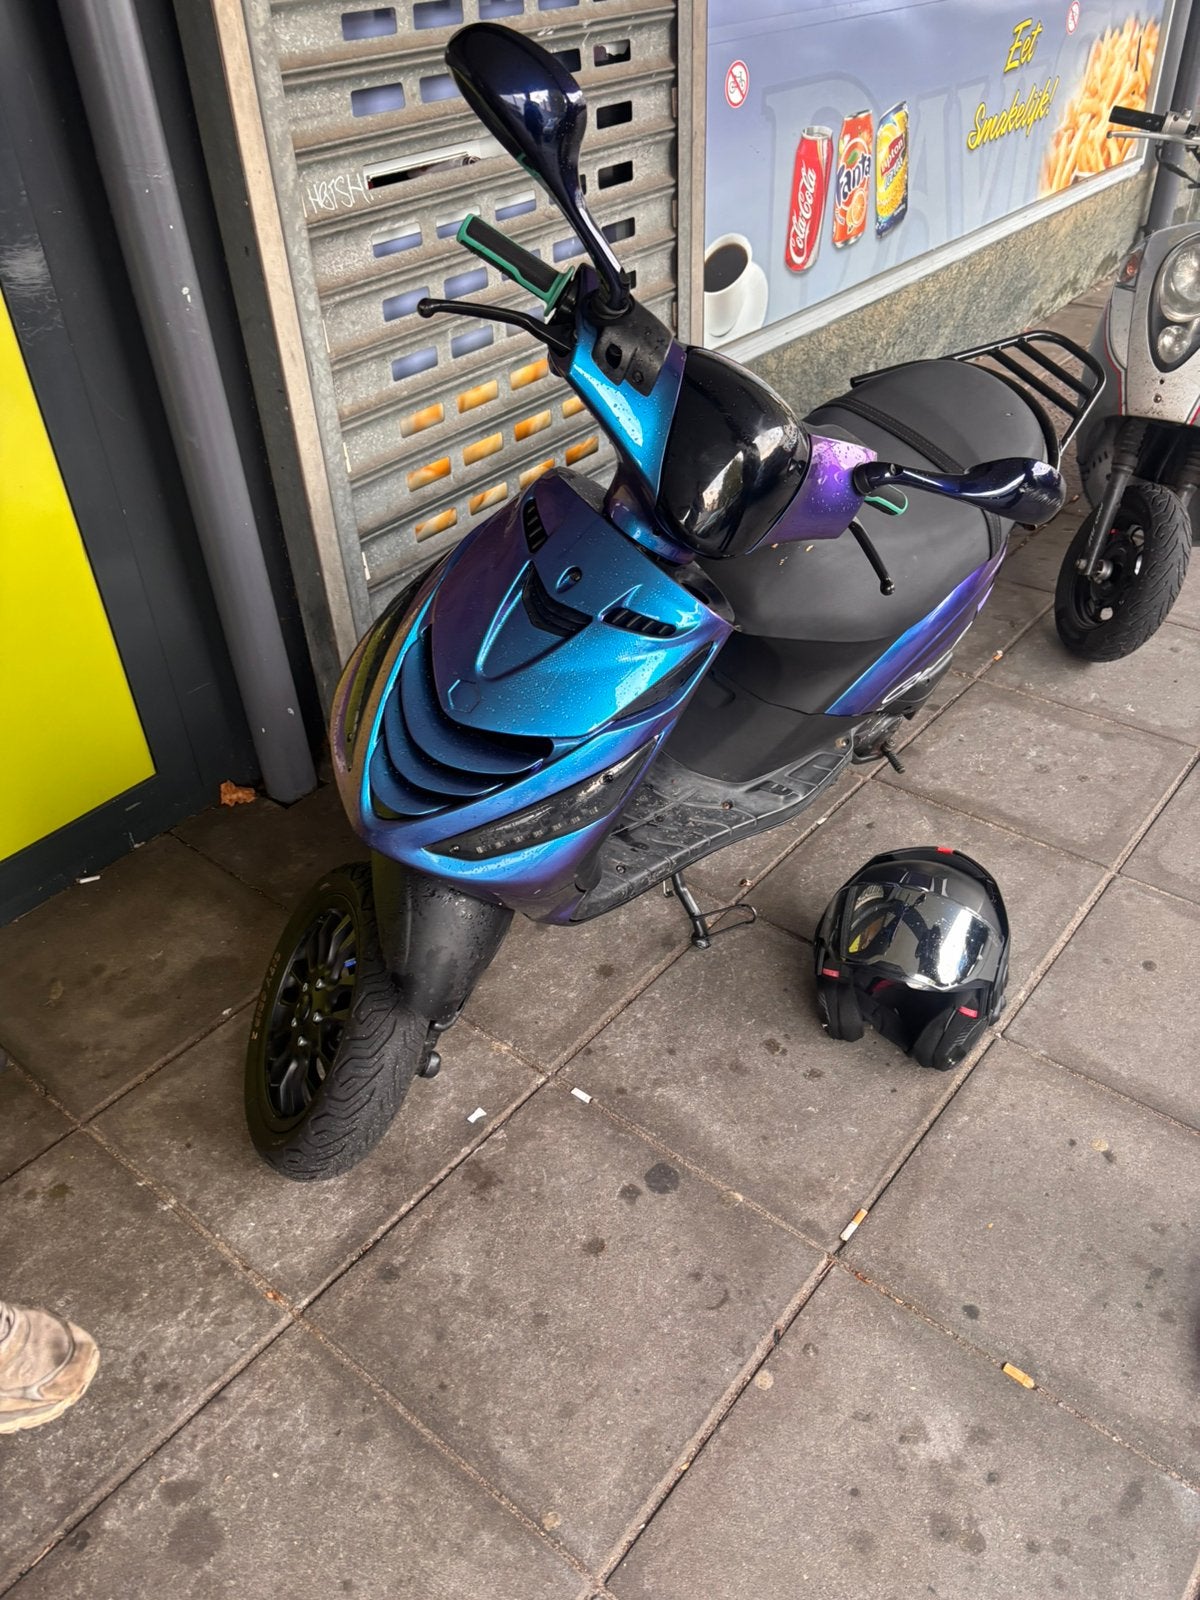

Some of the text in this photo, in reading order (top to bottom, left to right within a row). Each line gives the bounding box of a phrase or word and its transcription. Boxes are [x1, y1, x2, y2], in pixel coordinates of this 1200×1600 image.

[1004, 17, 1043, 74] Eet
[966, 75, 1060, 151] Smakelijk!
[835, 152, 872, 209] Fanta
